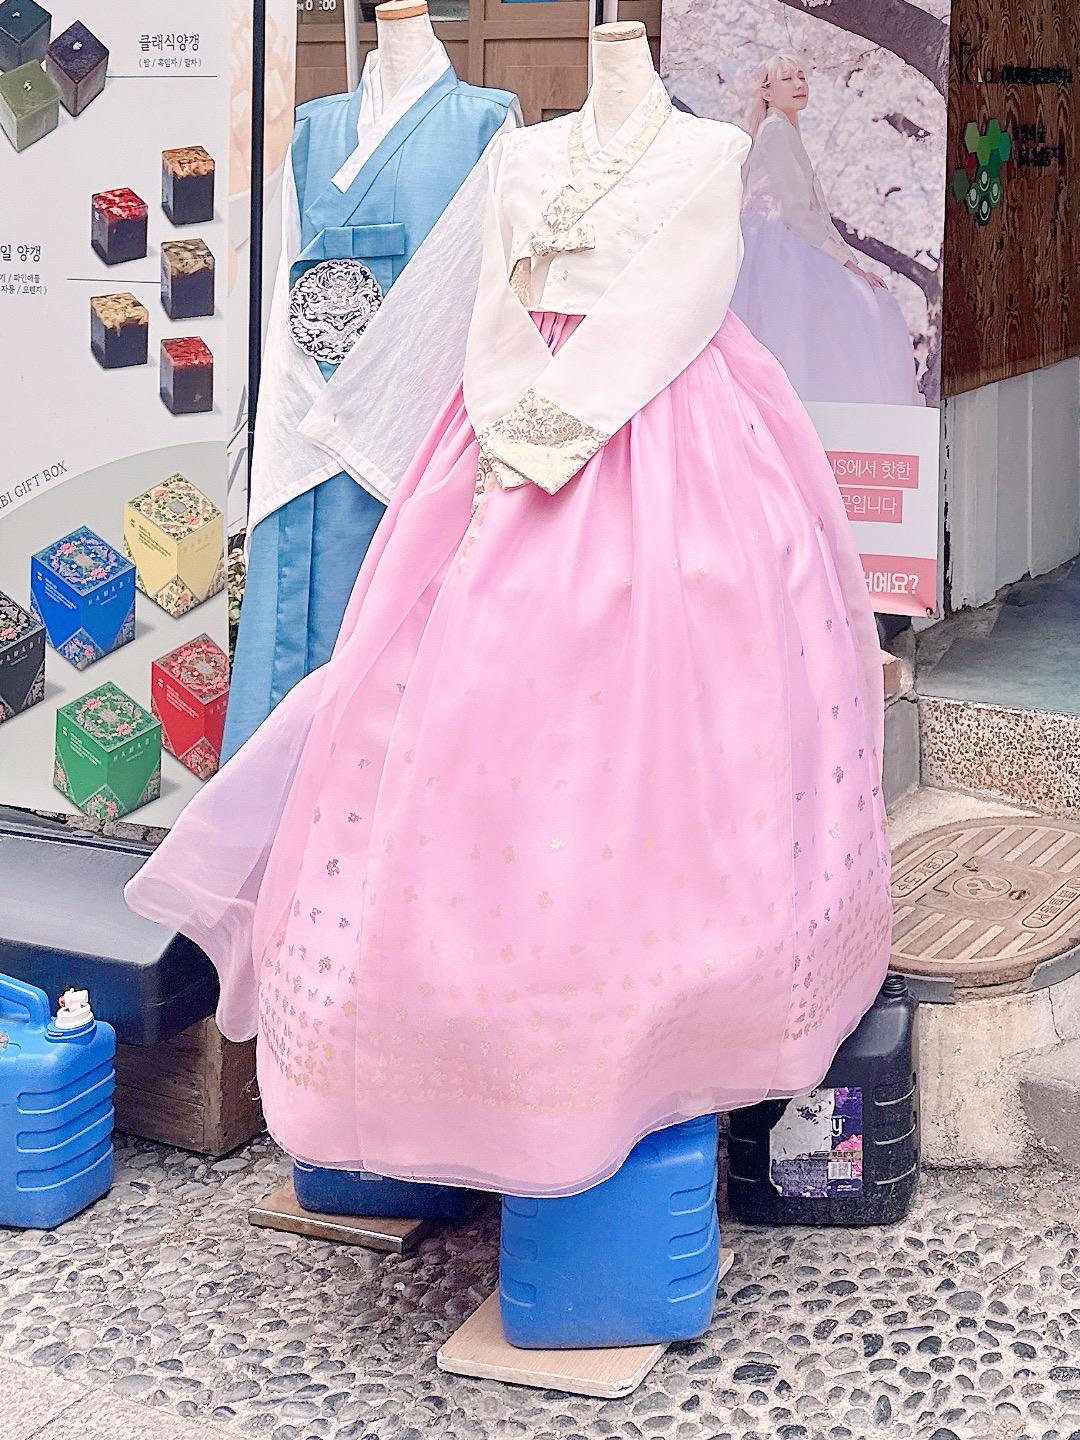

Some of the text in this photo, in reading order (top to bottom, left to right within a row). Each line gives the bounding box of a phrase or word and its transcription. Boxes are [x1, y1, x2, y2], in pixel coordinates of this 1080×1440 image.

[139, 33, 200, 52] 클래식양갱
[17, 244, 41, 262] 양갱
[14, 473, 42, 499] GIFT
[43, 460, 69, 483] BOX
[881, 461, 912, 481] 핫한
